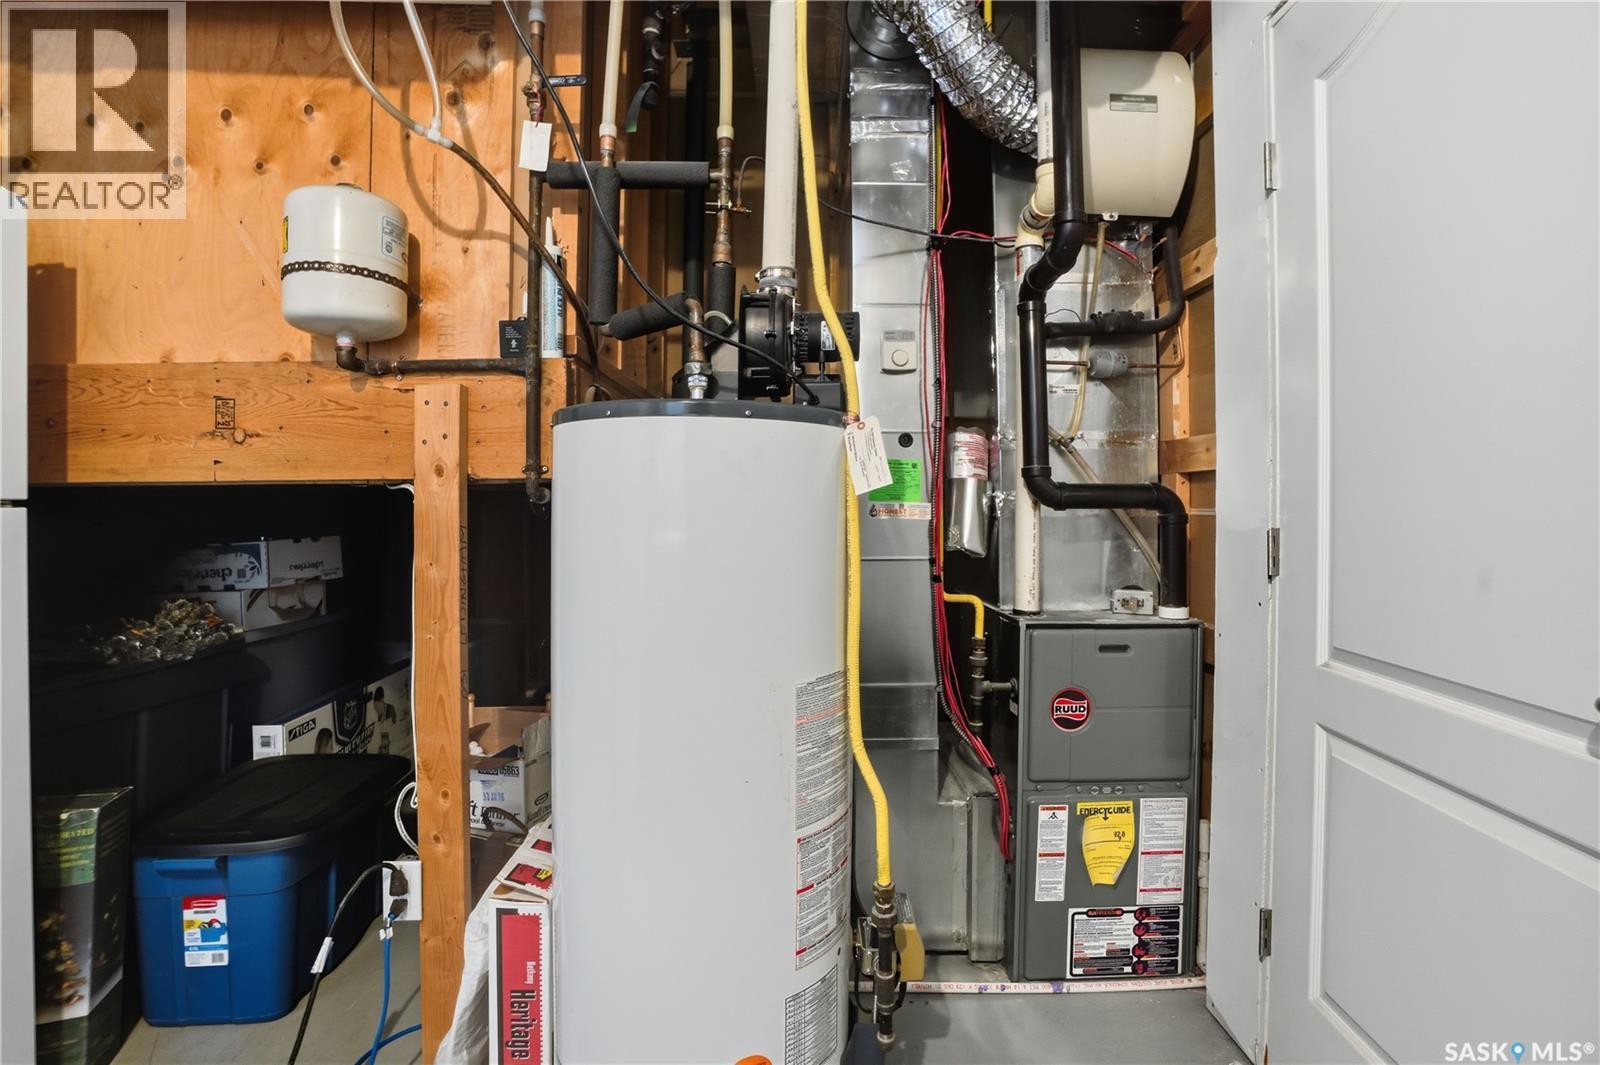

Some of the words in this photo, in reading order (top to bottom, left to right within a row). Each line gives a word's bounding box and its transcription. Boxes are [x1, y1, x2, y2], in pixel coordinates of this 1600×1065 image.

[1055, 705, 1086, 713] RUUD
[289, 720, 316, 741] STIGA
[1080, 806, 1131, 815] ENERGYGUIDE
[525, 961, 536, 985] Bethany
[506, 989, 537, 1060] Heritage
